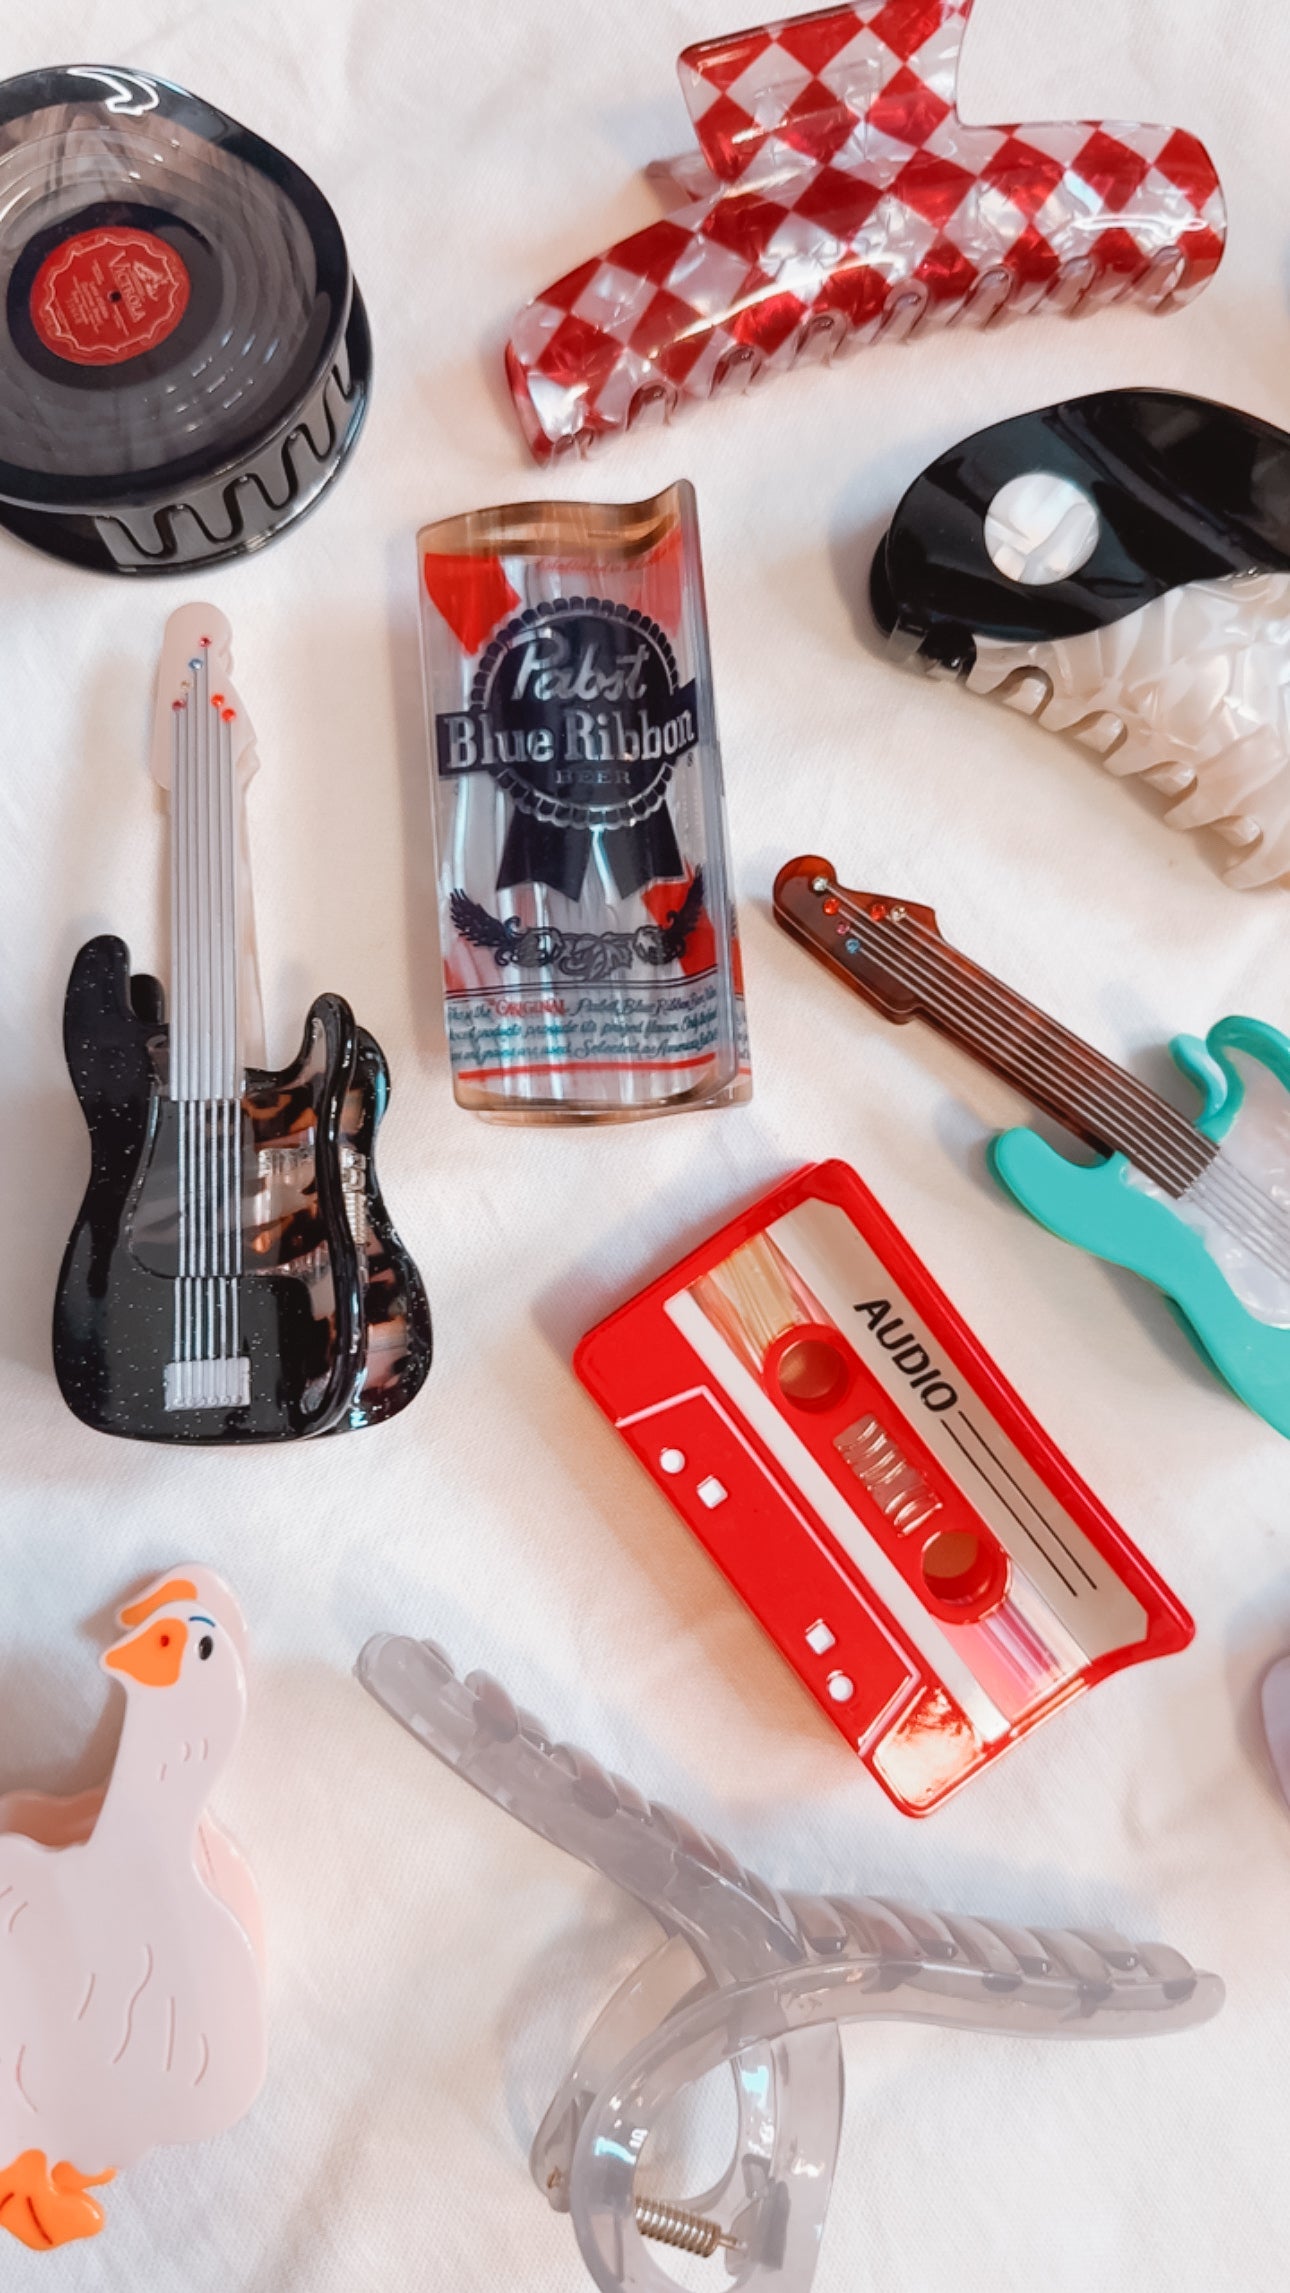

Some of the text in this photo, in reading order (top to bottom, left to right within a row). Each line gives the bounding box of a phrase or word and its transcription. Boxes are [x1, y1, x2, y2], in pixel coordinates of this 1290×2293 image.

[509, 626, 650, 701] Pabst
[443, 708, 696, 769] Blue Ribbon
[555, 769, 631, 785] BEER
[853, 1299, 958, 1412] AUDIO
